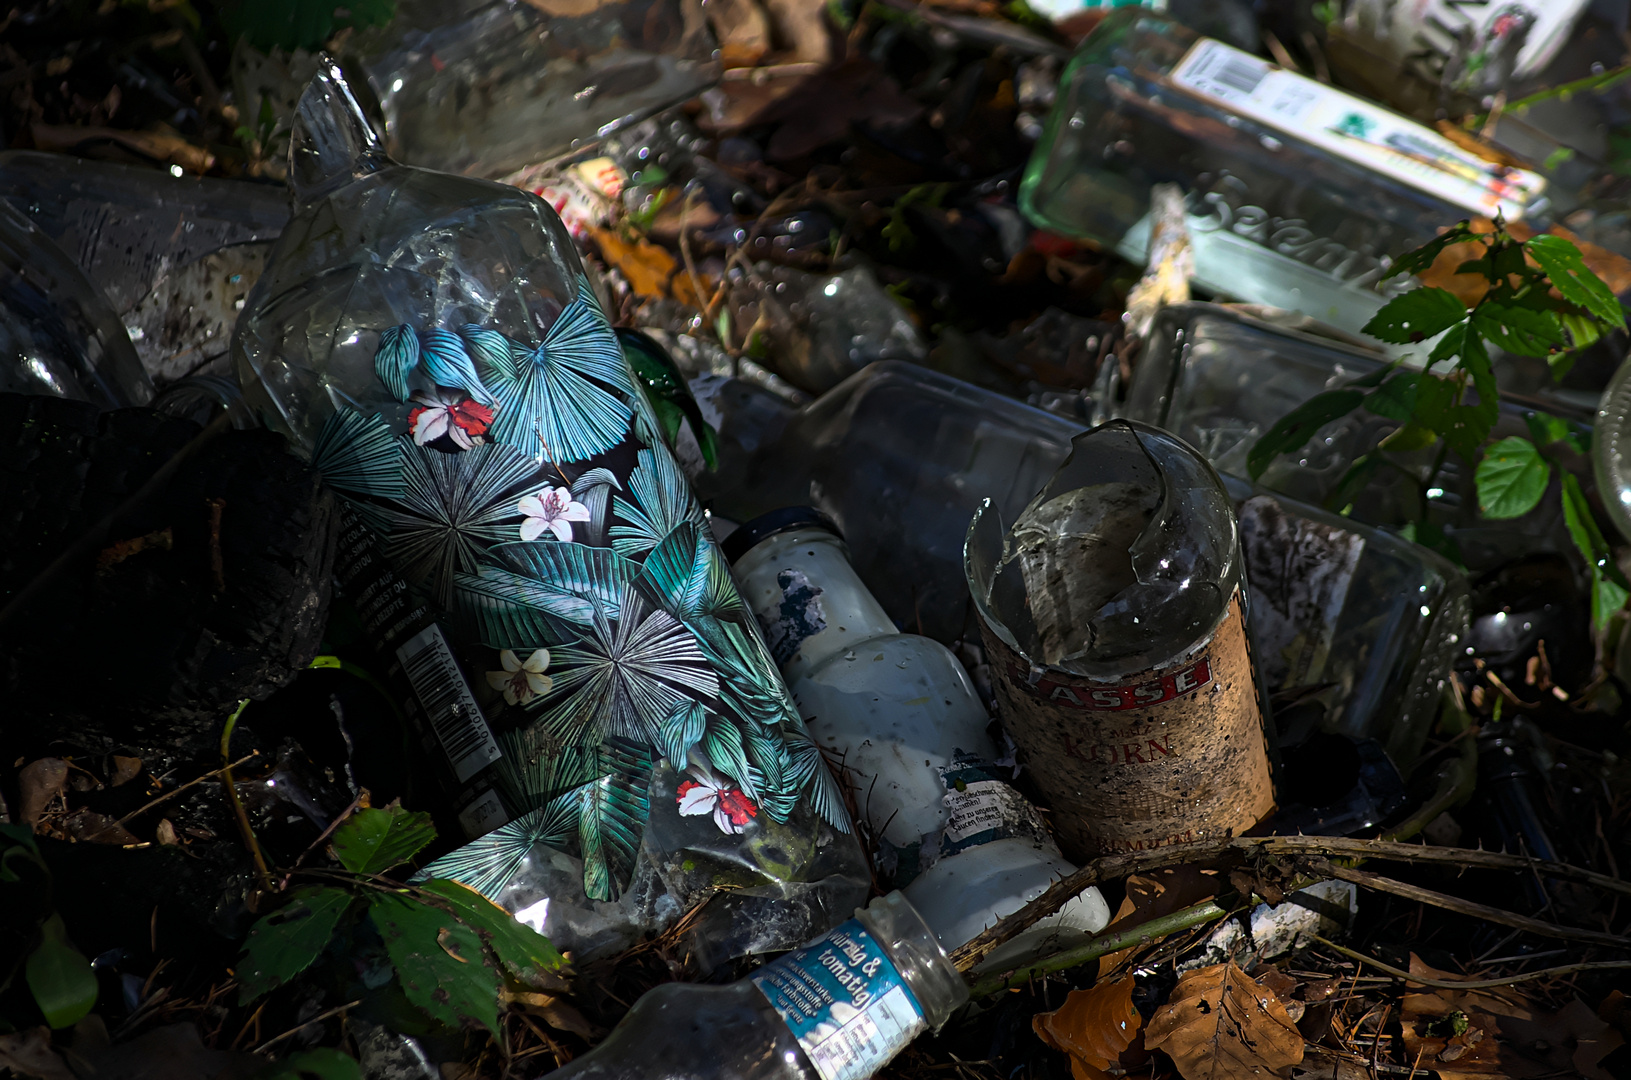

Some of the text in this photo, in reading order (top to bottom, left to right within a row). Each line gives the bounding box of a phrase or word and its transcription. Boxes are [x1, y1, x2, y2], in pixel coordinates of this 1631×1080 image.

[347, 524, 367, 540] COLA
[351, 532, 377, 557] SIMPLY
[380, 571, 394, 586] AUF
[393, 579, 406, 593] DU
[436, 644, 464, 688] 012171
[461, 695, 488, 739] 010677
[1063, 733, 1171, 764] KORN
[952, 819, 977, 832] Saucen
[827, 931, 868, 965] würzig
[861, 956, 882, 978] &
[818, 948, 870, 1007] tomatig
[786, 1005, 803, 1024] Gesetz
